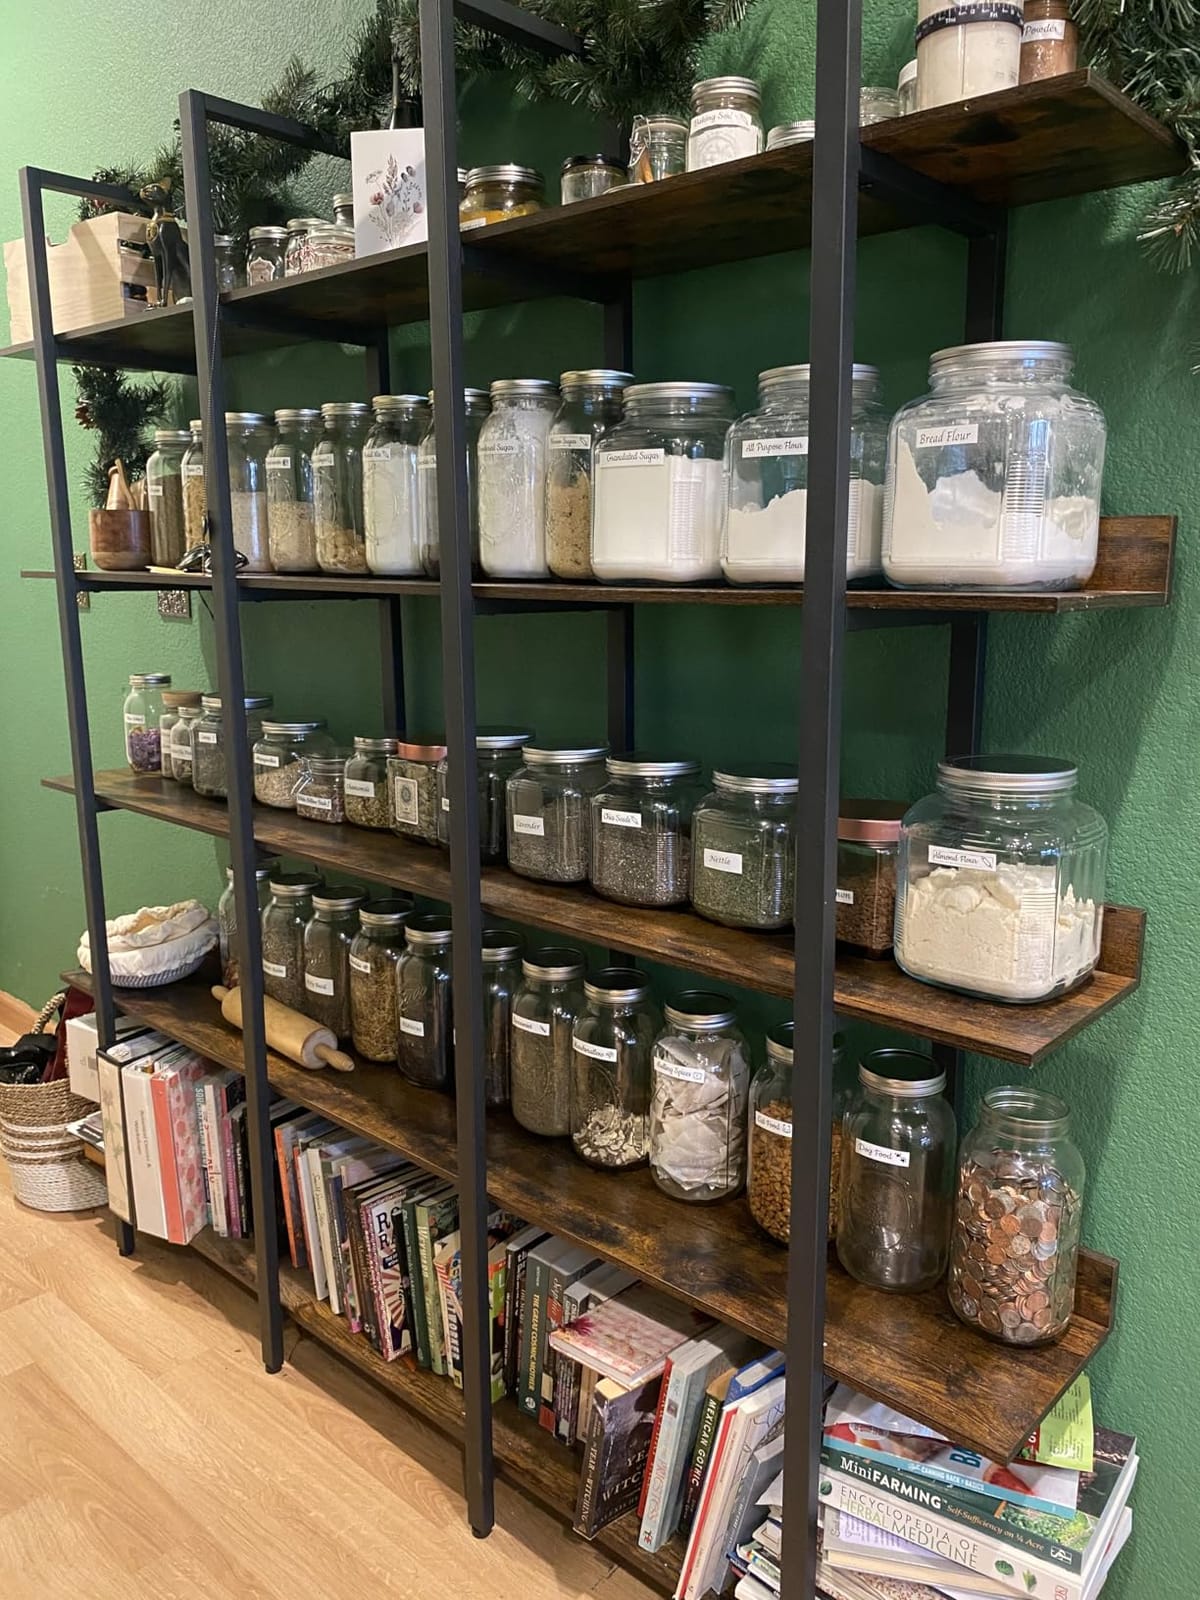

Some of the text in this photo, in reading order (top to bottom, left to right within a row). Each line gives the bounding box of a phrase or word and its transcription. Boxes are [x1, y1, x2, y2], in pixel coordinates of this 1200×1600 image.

[745, 440, 803, 453] All Purpose Flour
[919, 428, 972, 444] Bread Flour
[606, 451, 660, 463] Granulated Sugar
[708, 854, 731, 866] Nettle
[857, 1142, 893, 1160] Dog Food
[531, 1307, 539, 1331] GREAT
[529, 1331, 538, 1360] COSMIC
[527, 1360, 536, 1392] MOTHER
[691, 1399, 717, 1487] MEXICAN GOTHIC
[587, 1447, 598, 1471] YEAR
[581, 1477, 594, 1521] WITCHING
[841, 1485, 950, 1543] ENCYCLOPEDIA
[960, 1537, 979, 1554] OF
[946, 1504, 1003, 1535] Self-Sufficiency
[1003, 1530, 1014, 1539] on
[1025, 1538, 1045, 1553] Acre
[840, 1497, 887, 1529] HERBAL
[891, 1518, 978, 1570] MEDICINE
